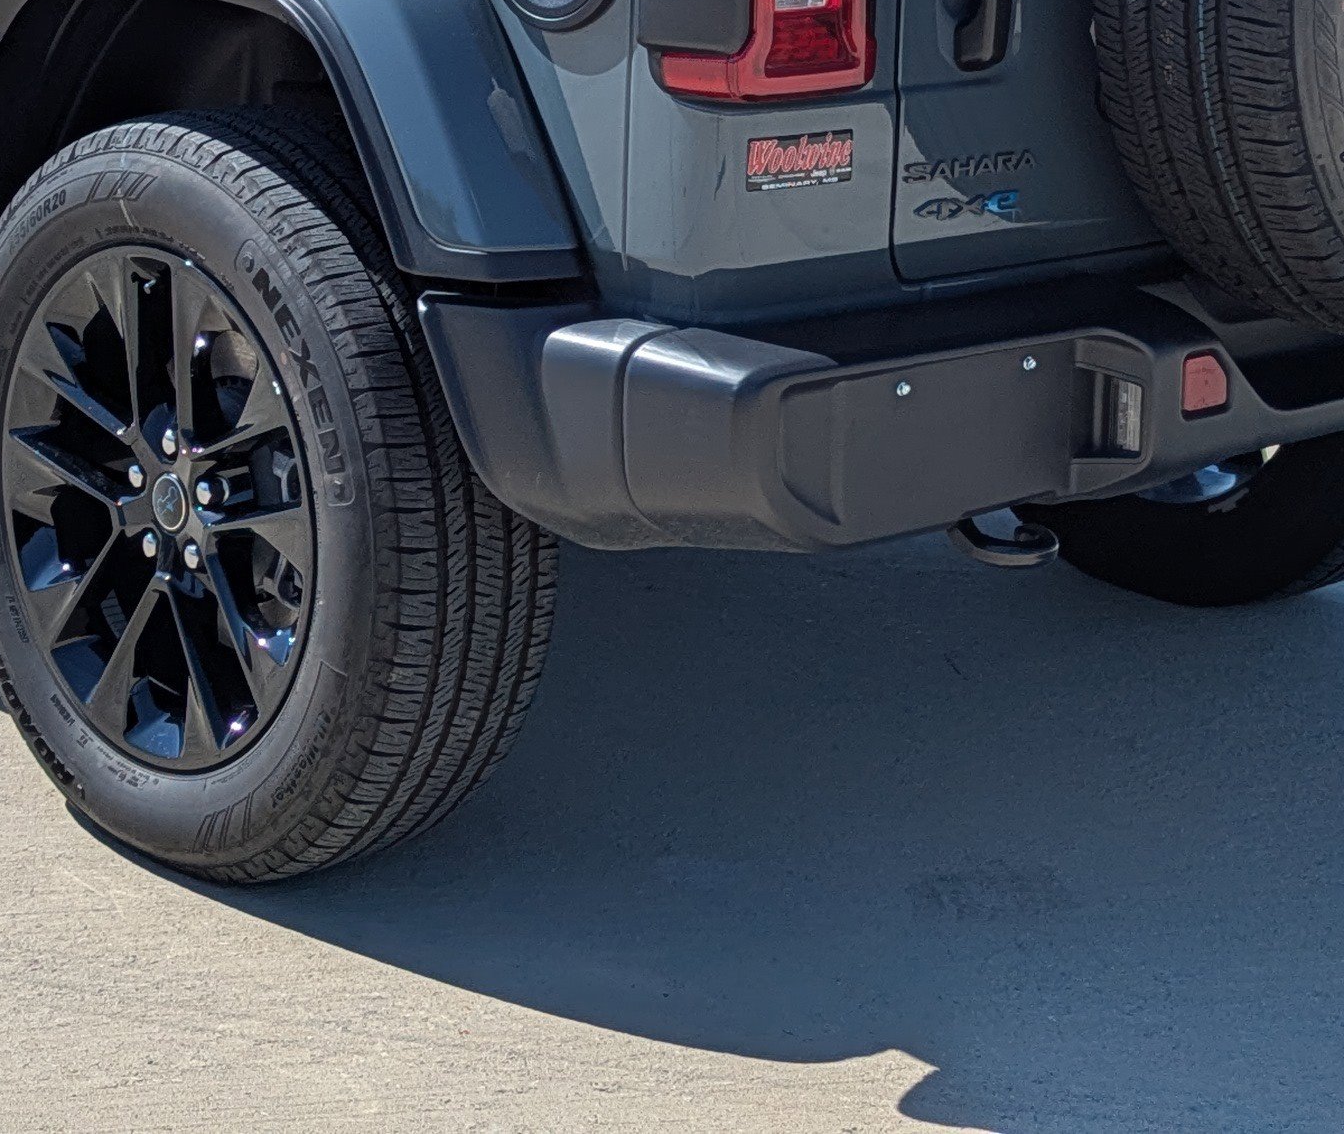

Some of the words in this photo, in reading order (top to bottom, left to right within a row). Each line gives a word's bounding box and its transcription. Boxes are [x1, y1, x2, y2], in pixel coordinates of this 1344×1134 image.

[747, 132, 852, 175] Woolwine
[902, 149, 1036, 184] SAHARA
[252, 267, 346, 474] NEXEN
